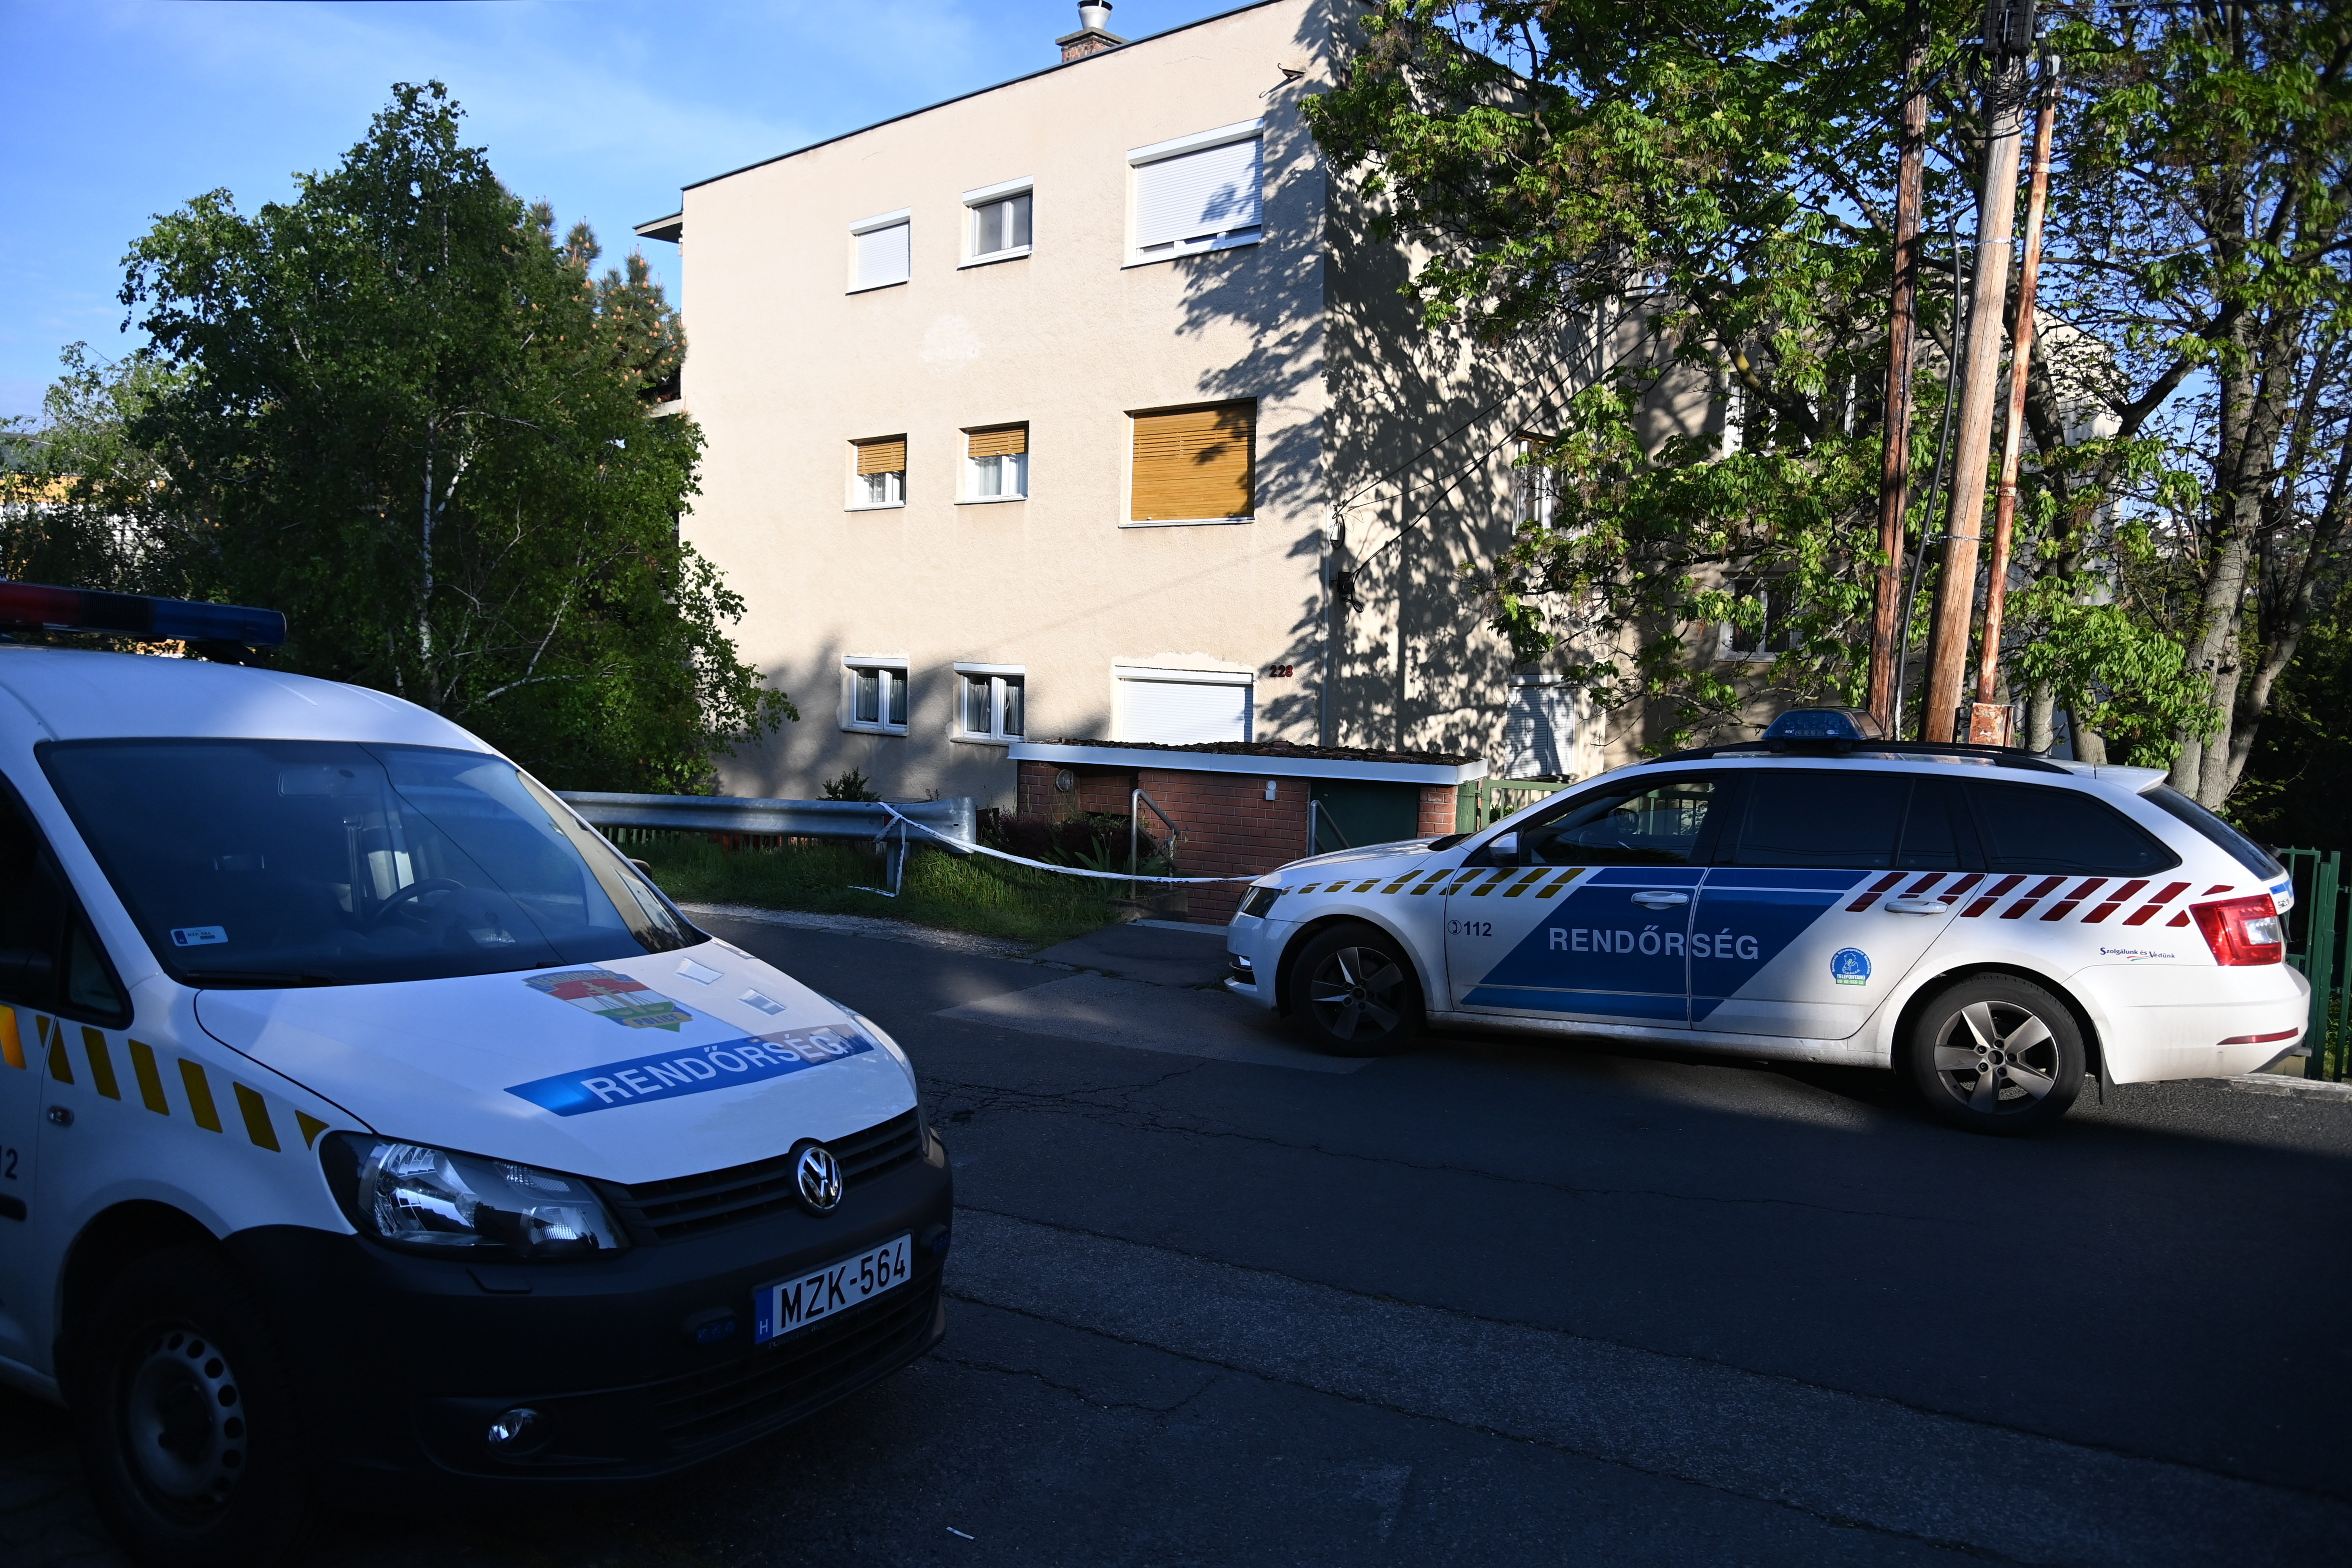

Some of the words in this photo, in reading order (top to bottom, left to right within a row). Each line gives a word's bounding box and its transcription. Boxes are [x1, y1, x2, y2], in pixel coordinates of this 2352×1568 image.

[1269, 665, 1293, 678] 228
[1464, 921, 1492, 937] 112
[1549, 925, 1759, 960] RENDŐRSÉG
[2100, 947, 2138, 955] Szolgálunk
[534, 971, 617, 987] RENDŐRSÉG
[632, 1013, 682, 1026] POLICE
[580, 1033, 847, 1104] RENDŐRSÉG
[781, 1241, 906, 1329] MZK-564
[760, 1318, 768, 1335] H
